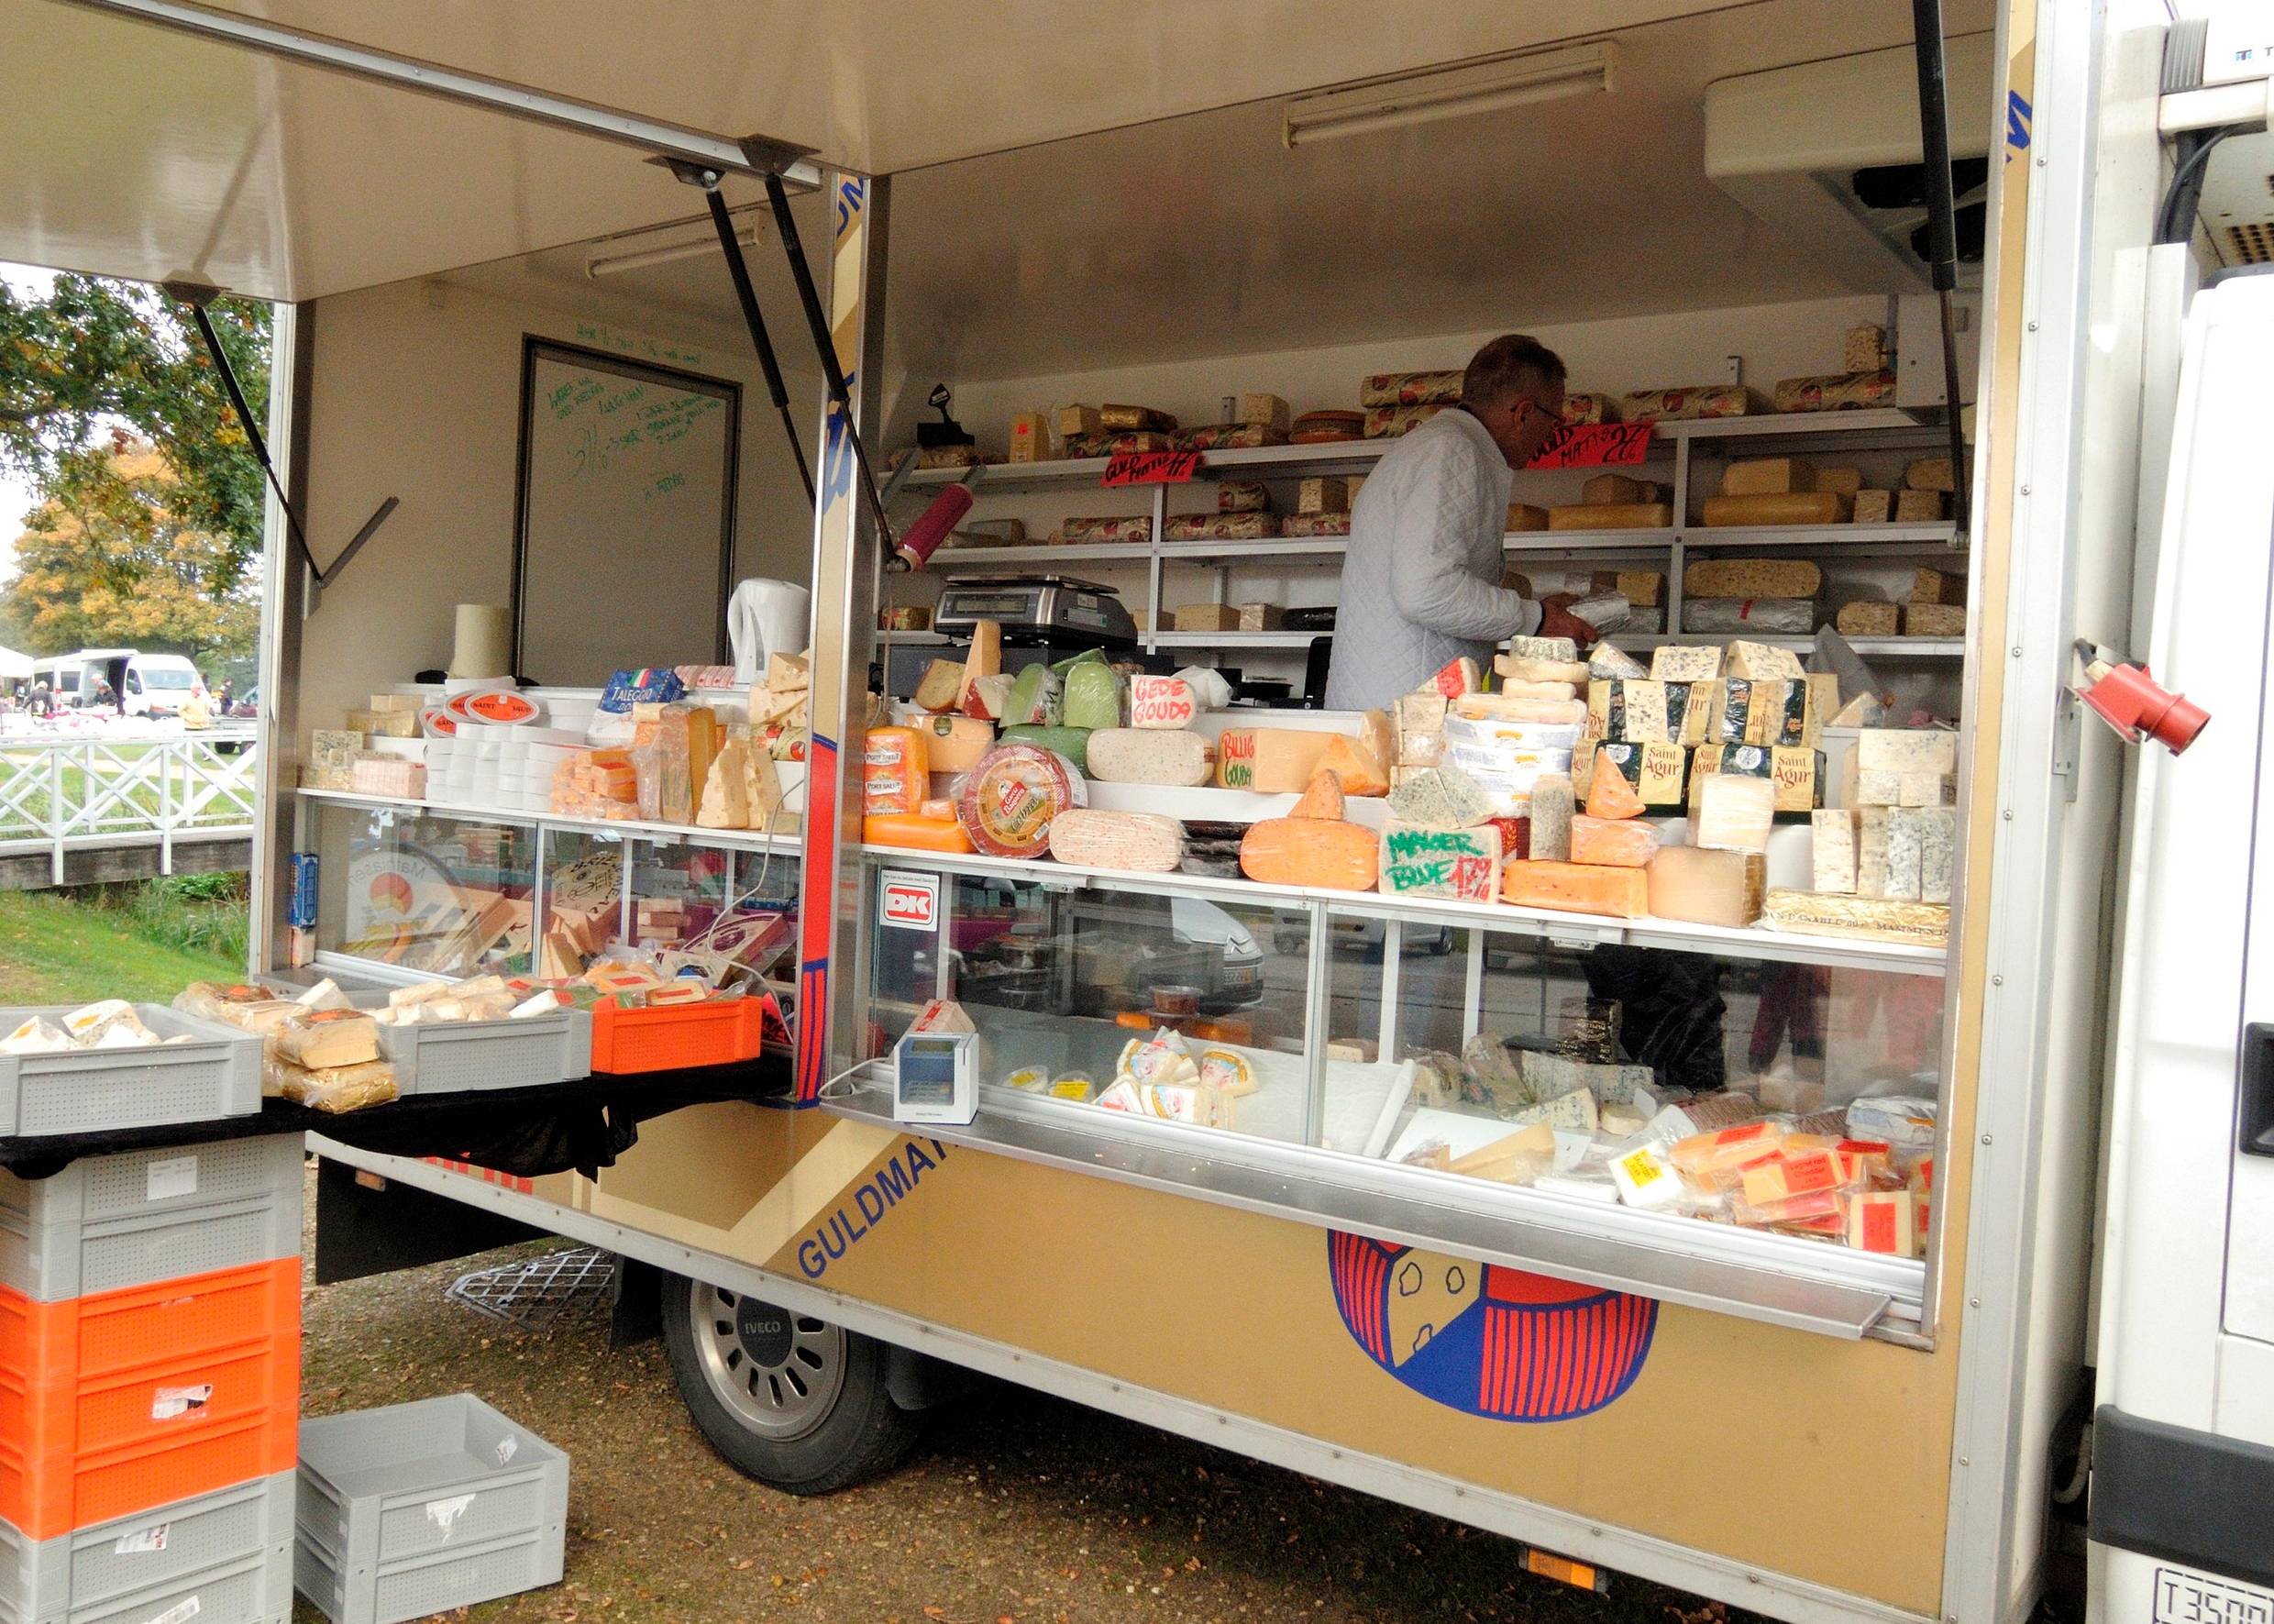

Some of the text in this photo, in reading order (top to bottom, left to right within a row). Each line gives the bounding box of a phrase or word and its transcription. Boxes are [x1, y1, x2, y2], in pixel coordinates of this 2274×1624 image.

[612, 687, 653, 702] TALEGGIO
[1133, 702, 1191, 724] GOUDA
[1649, 747, 1677, 760] Saint
[1778, 755, 1806, 768] Saint
[1644, 759, 1683, 780] Agur
[1774, 766, 1811, 788] Agur
[799, 1136, 948, 1279] GULDMAT
[745, 1320, 781, 1334] IVECO
